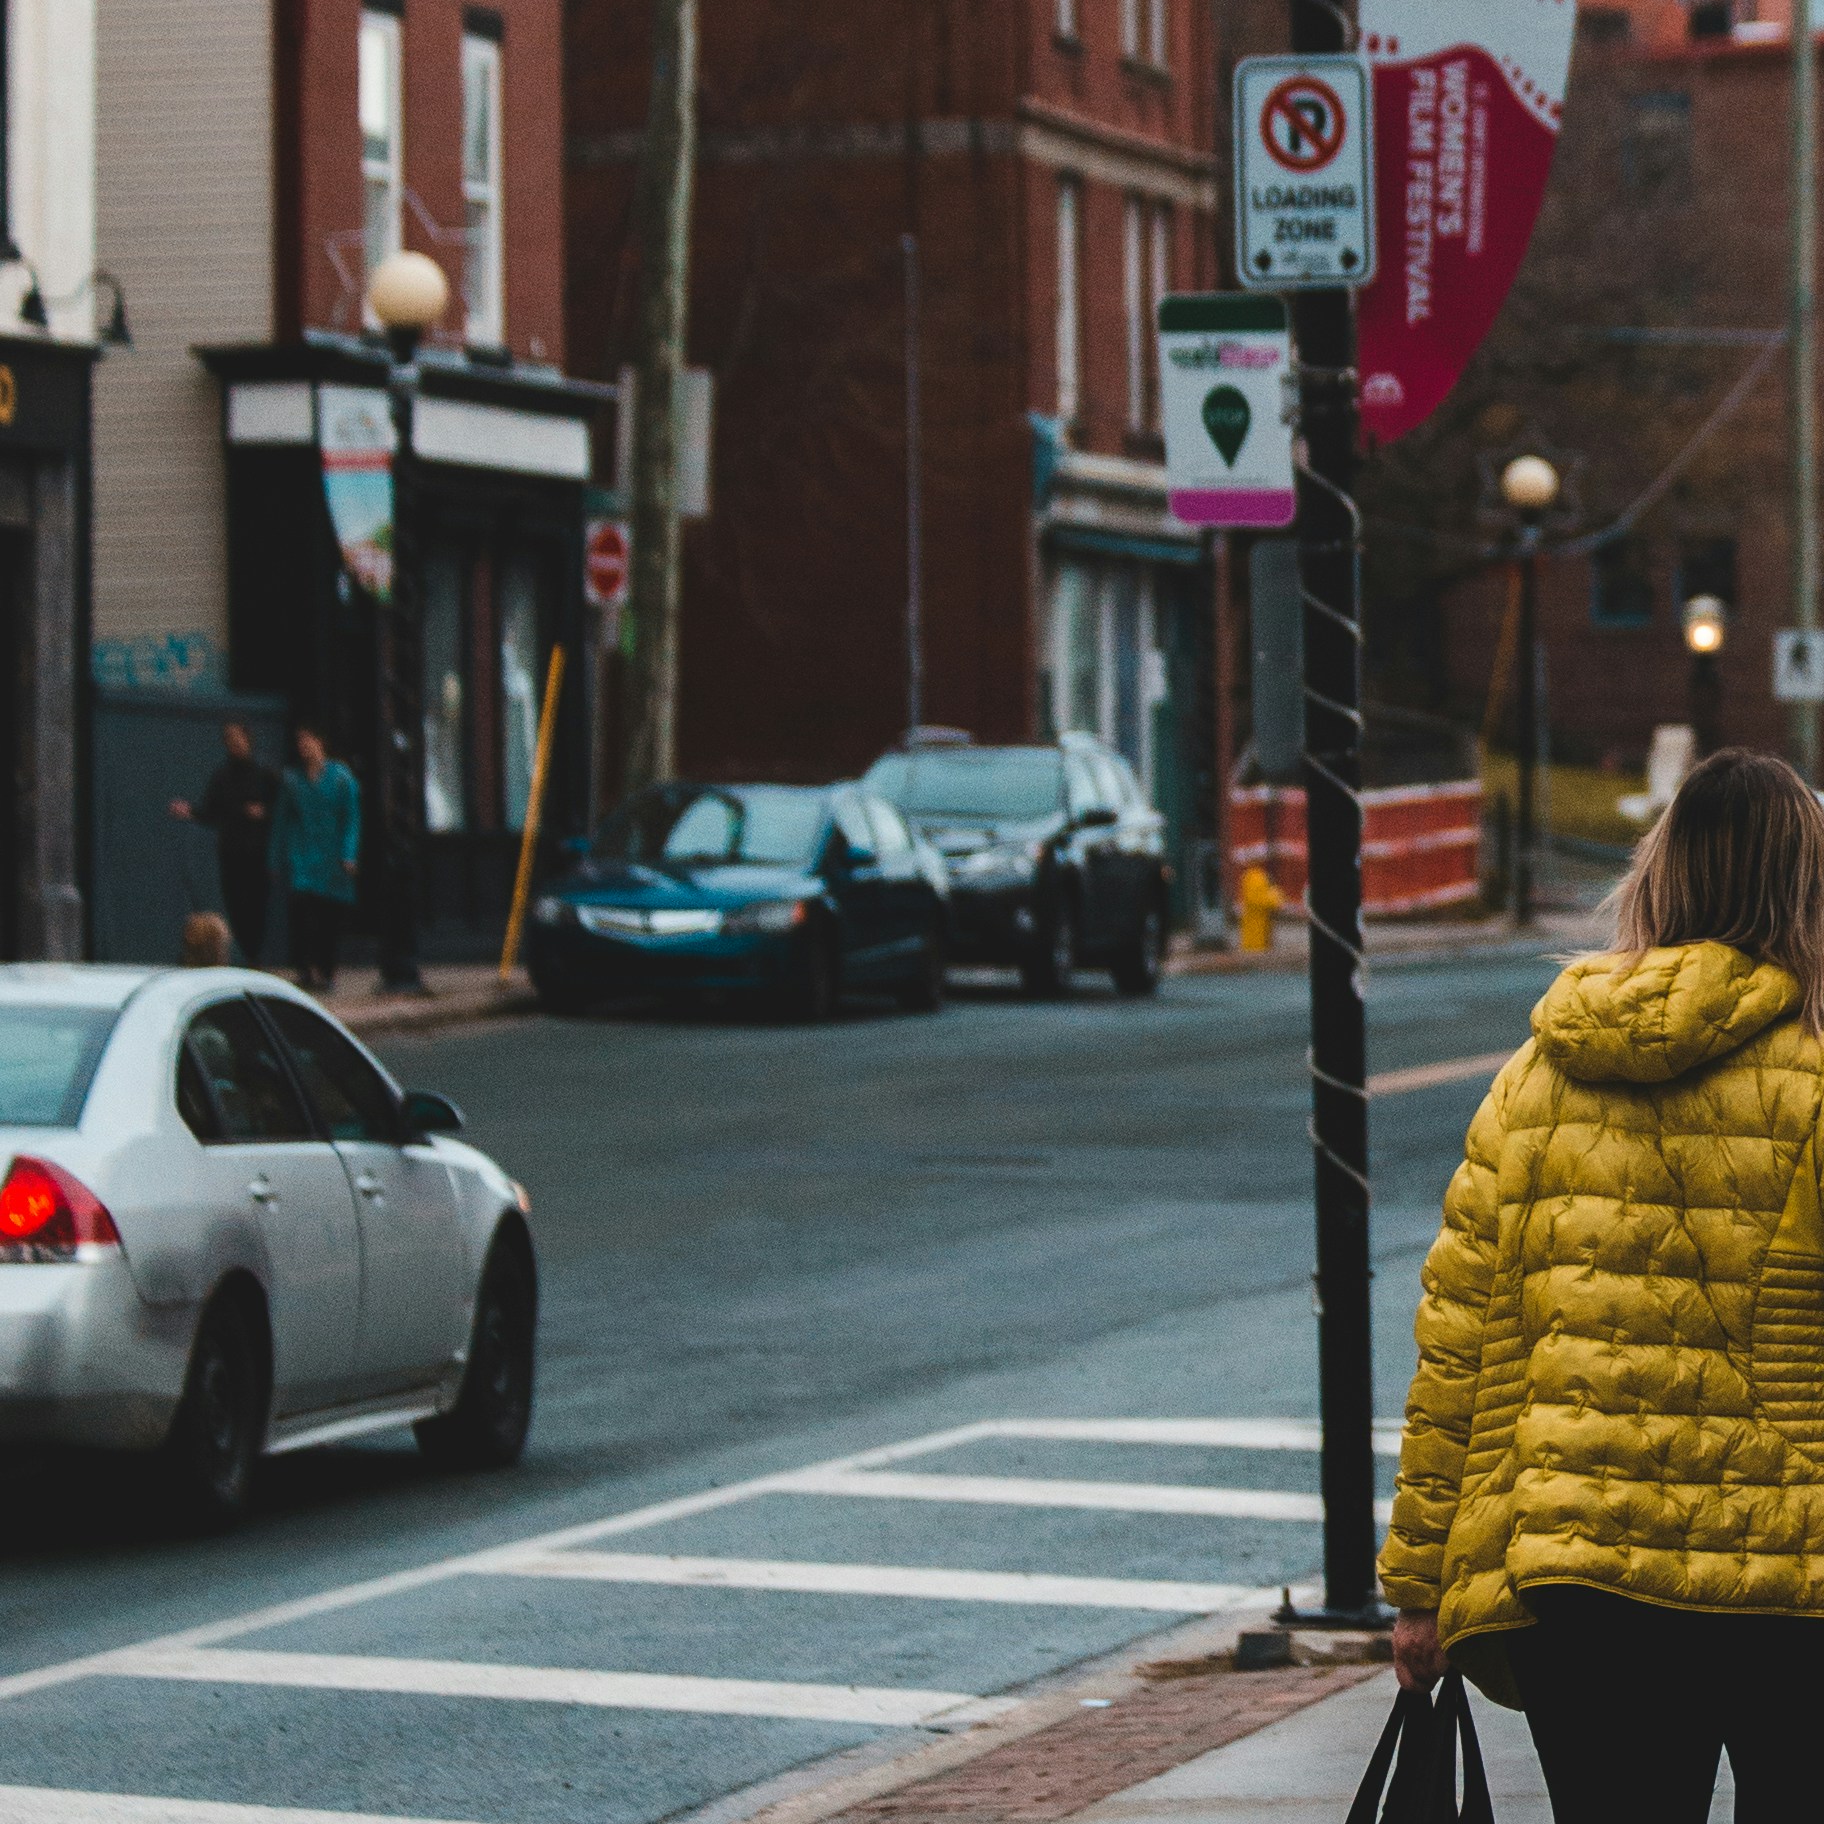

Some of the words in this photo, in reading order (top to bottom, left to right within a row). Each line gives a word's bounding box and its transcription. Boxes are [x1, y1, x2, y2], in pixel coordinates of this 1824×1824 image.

[1408, 68, 1437, 155] FILM
[1437, 59, 1469, 238] WOMEN'S
[1251, 184, 1356, 211] LOADING
[1274, 218, 1335, 242] ZONE
[1405, 159, 1434, 327] FESTIVAL
